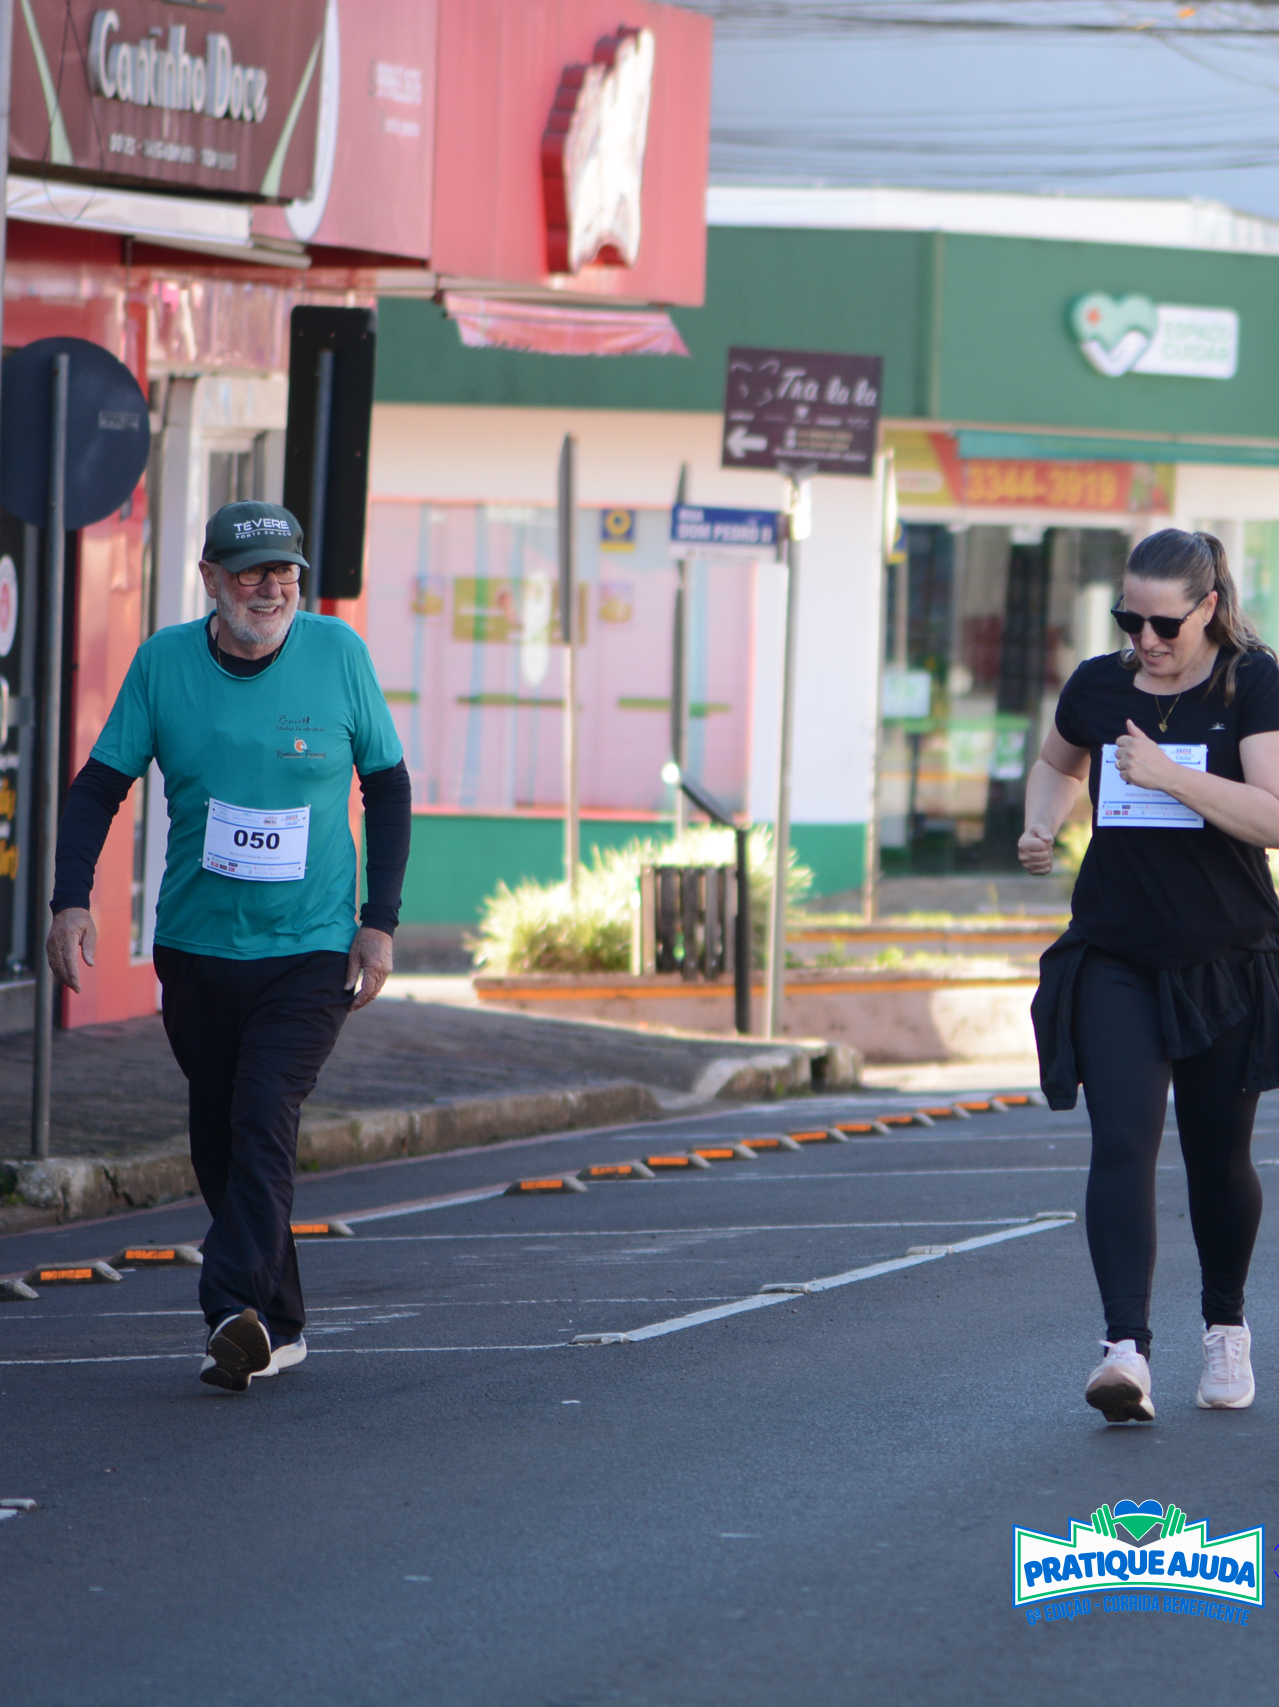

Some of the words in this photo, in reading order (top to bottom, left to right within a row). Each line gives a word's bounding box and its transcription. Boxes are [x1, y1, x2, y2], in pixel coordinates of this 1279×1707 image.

[89, 9, 206, 113] Cantinho
[206, 32, 268, 123] Doce
[827, 377, 849, 404] la
[855, 378, 877, 406] la
[679, 523, 711, 540] DOM
[713, 525, 759, 542] PEDRO
[233, 829, 281, 850] 050
